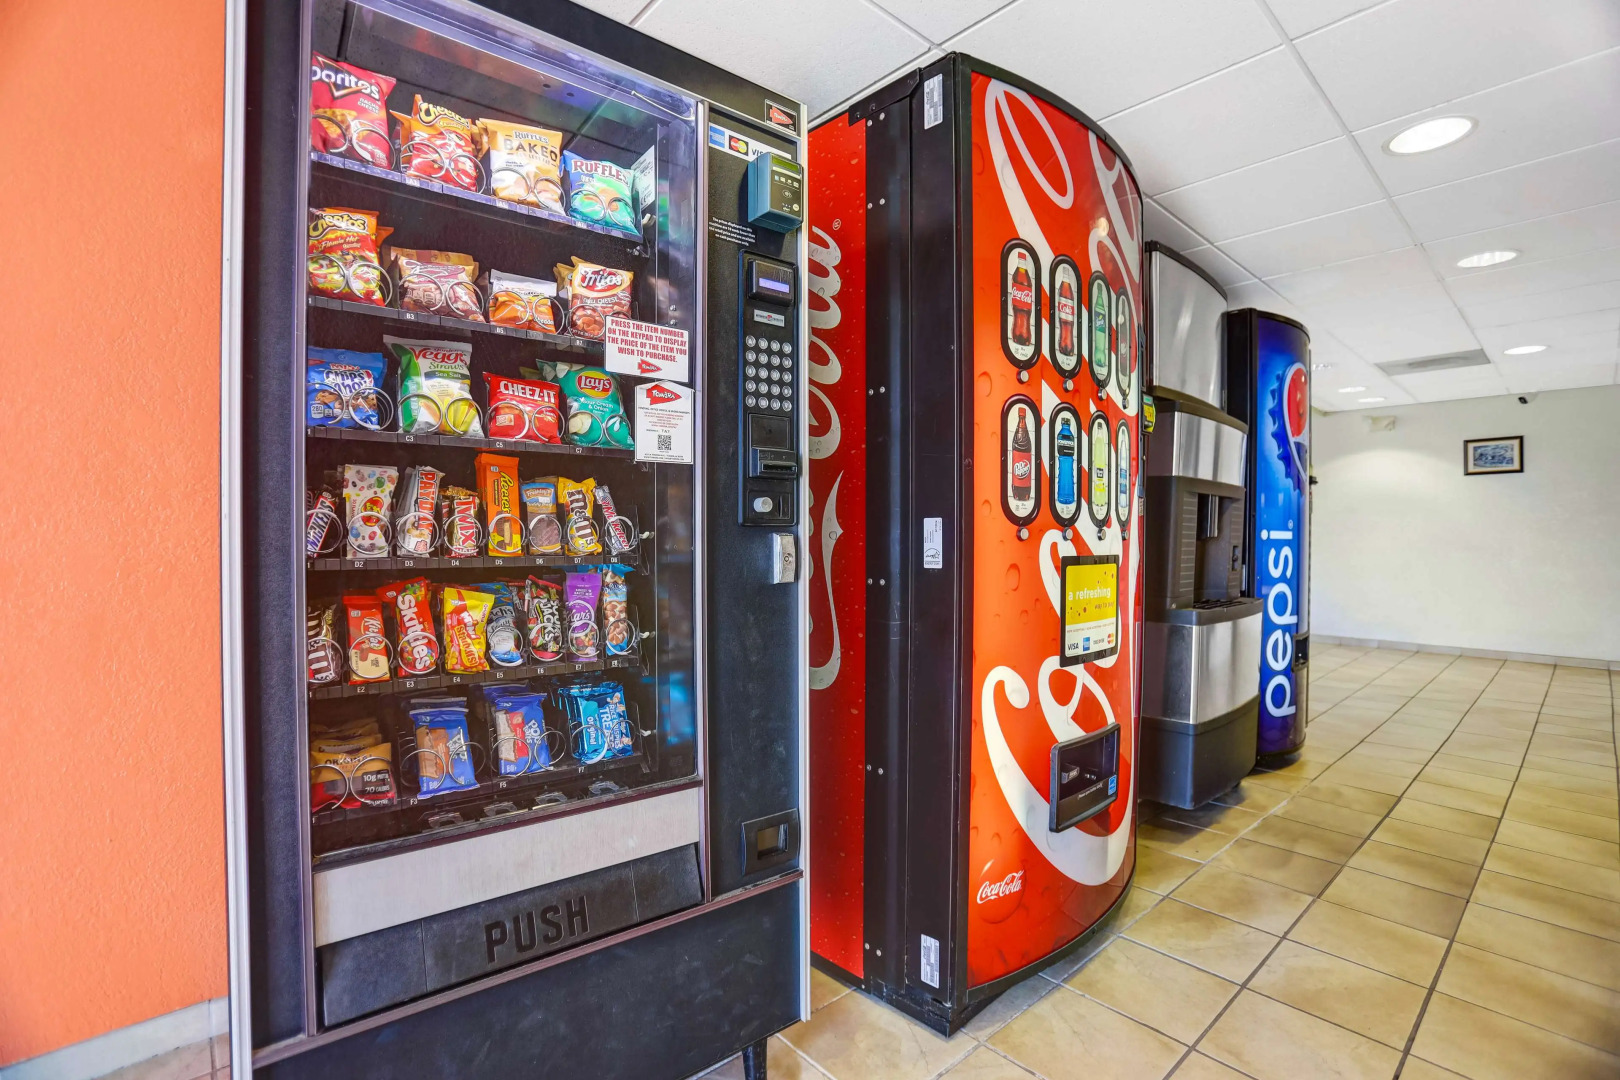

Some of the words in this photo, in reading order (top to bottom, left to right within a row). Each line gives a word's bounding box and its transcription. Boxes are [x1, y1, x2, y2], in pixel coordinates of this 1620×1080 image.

[513, 131, 550, 144] RUFFLES
[572, 159, 631, 188] RUFFLES
[580, 270, 623, 287] Fritos
[1059, 302, 1073, 315] Coke
[607, 327, 617, 335] ON
[618, 329, 629, 337] THE
[630, 331, 654, 341] KEYPAD
[663, 337, 687, 347] DISPLAY
[611, 319, 631, 329] PRESS
[632, 323, 644, 332] THE
[644, 325, 659, 334] ITEM
[660, 328, 684, 338] NUMBER
[607, 336, 619, 345] THE
[620, 338, 638, 347] PRICE
[648, 343, 659, 351] THE
[660, 346, 674, 354] ITEM
[675, 348, 687, 356] YOU
[617, 347, 635, 356] WISH
[645, 351, 678, 363] PURCHASE.
[324, 370, 365, 382] Chips
[428, 362, 464, 370] Straws
[499, 380, 556, 404] CHEEZ-IT
[580, 375, 611, 392] Lay's
[418, 471, 437, 534] PAYDAY
[499, 471, 514, 514] Reese's
[307, 499, 334, 553] NICKERS
[455, 495, 477, 546] TWIX
[1068, 591, 1074, 601] a
[1075, 586, 1111, 601] refreshing
[540, 602, 554, 641] JACKS
[1260, 529, 1299, 719] pepsi
[396, 594, 431, 670] Skittles
[1067, 642, 1079, 651] VISA
[586, 716, 597, 745] Original
[363, 774, 377, 782] 10g
[364, 786, 375, 794] 70
[410, 798, 418, 806] F3
[976, 869, 1025, 905] Coca-Cola
[484, 895, 590, 965] PUSH
